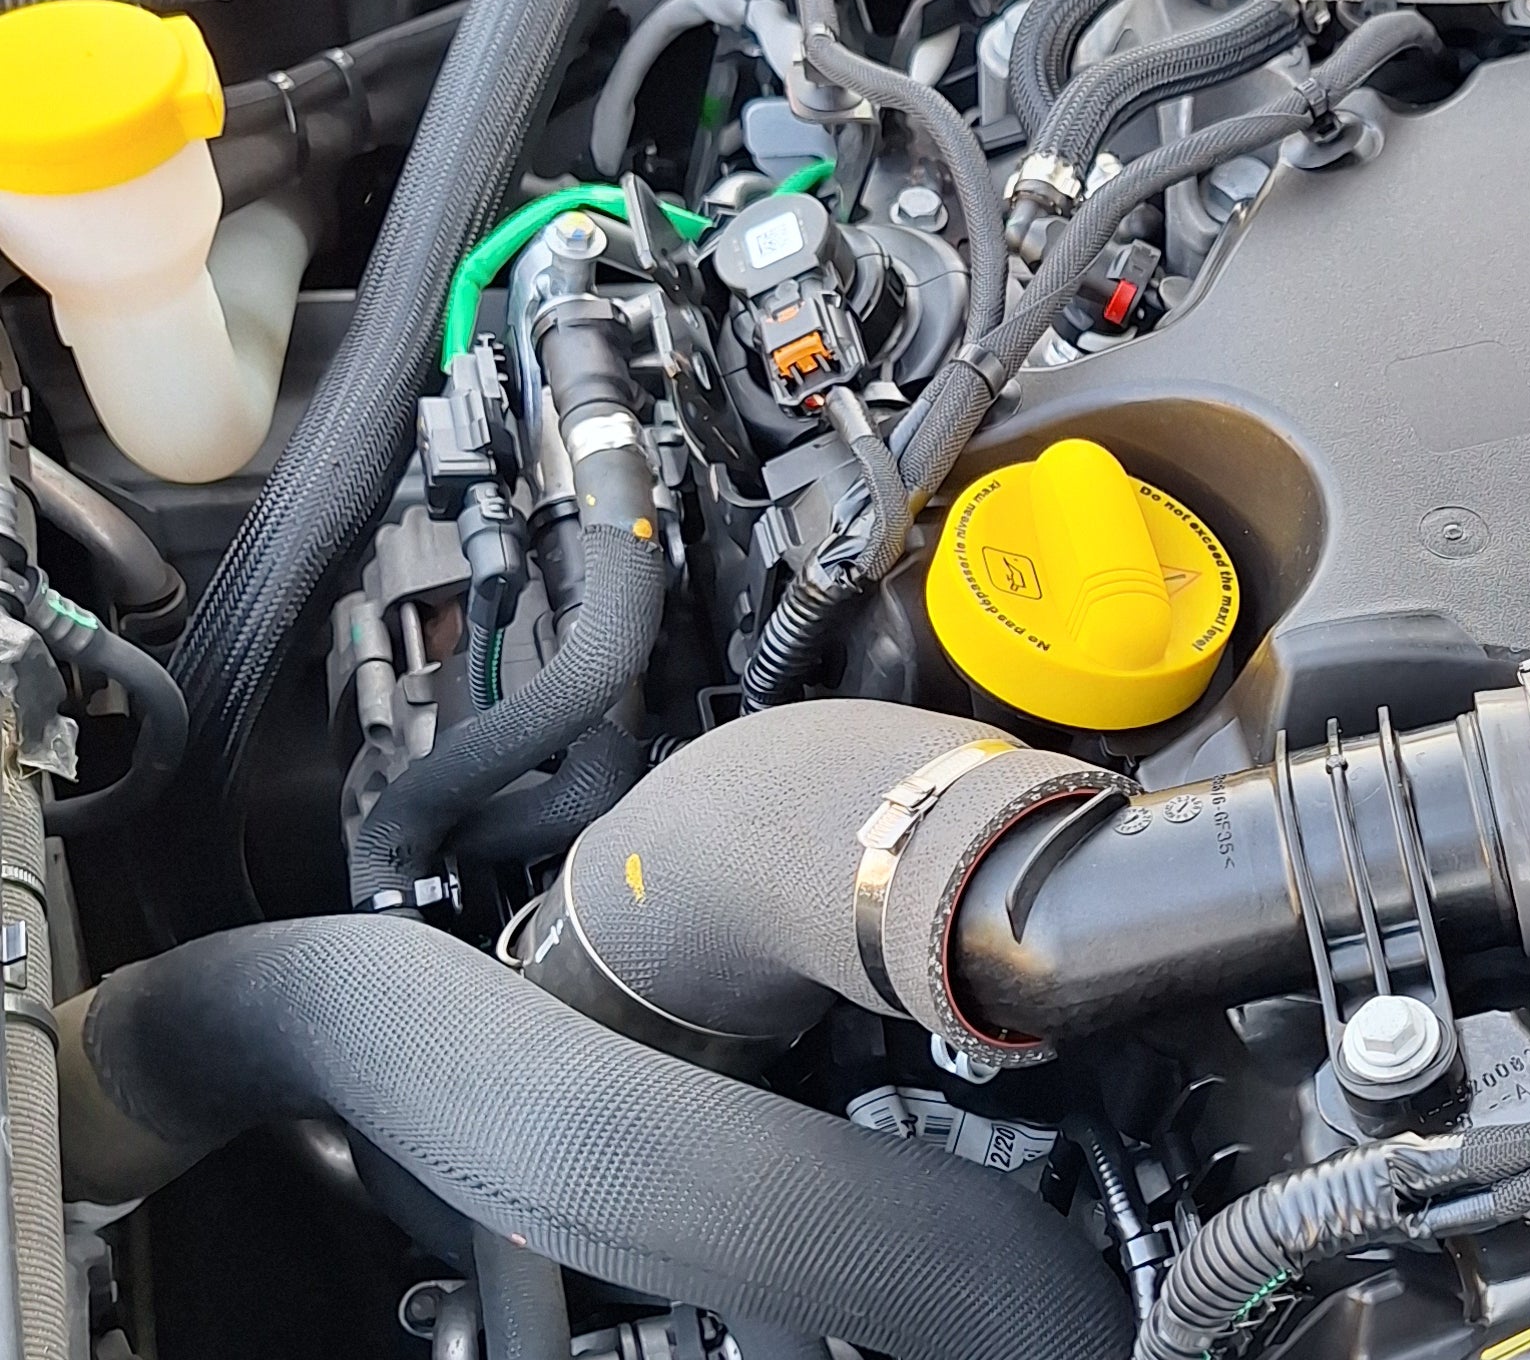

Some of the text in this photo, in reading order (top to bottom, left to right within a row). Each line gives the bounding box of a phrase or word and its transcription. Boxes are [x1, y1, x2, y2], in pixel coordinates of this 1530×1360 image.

[973, 478, 1002, 503] maxi
[954, 502, 976, 539] niveau
[1138, 485, 1233, 652] Do not exceed the maxi level
[997, 613, 1027, 636] pas
[1027, 633, 1051, 652] Ne
